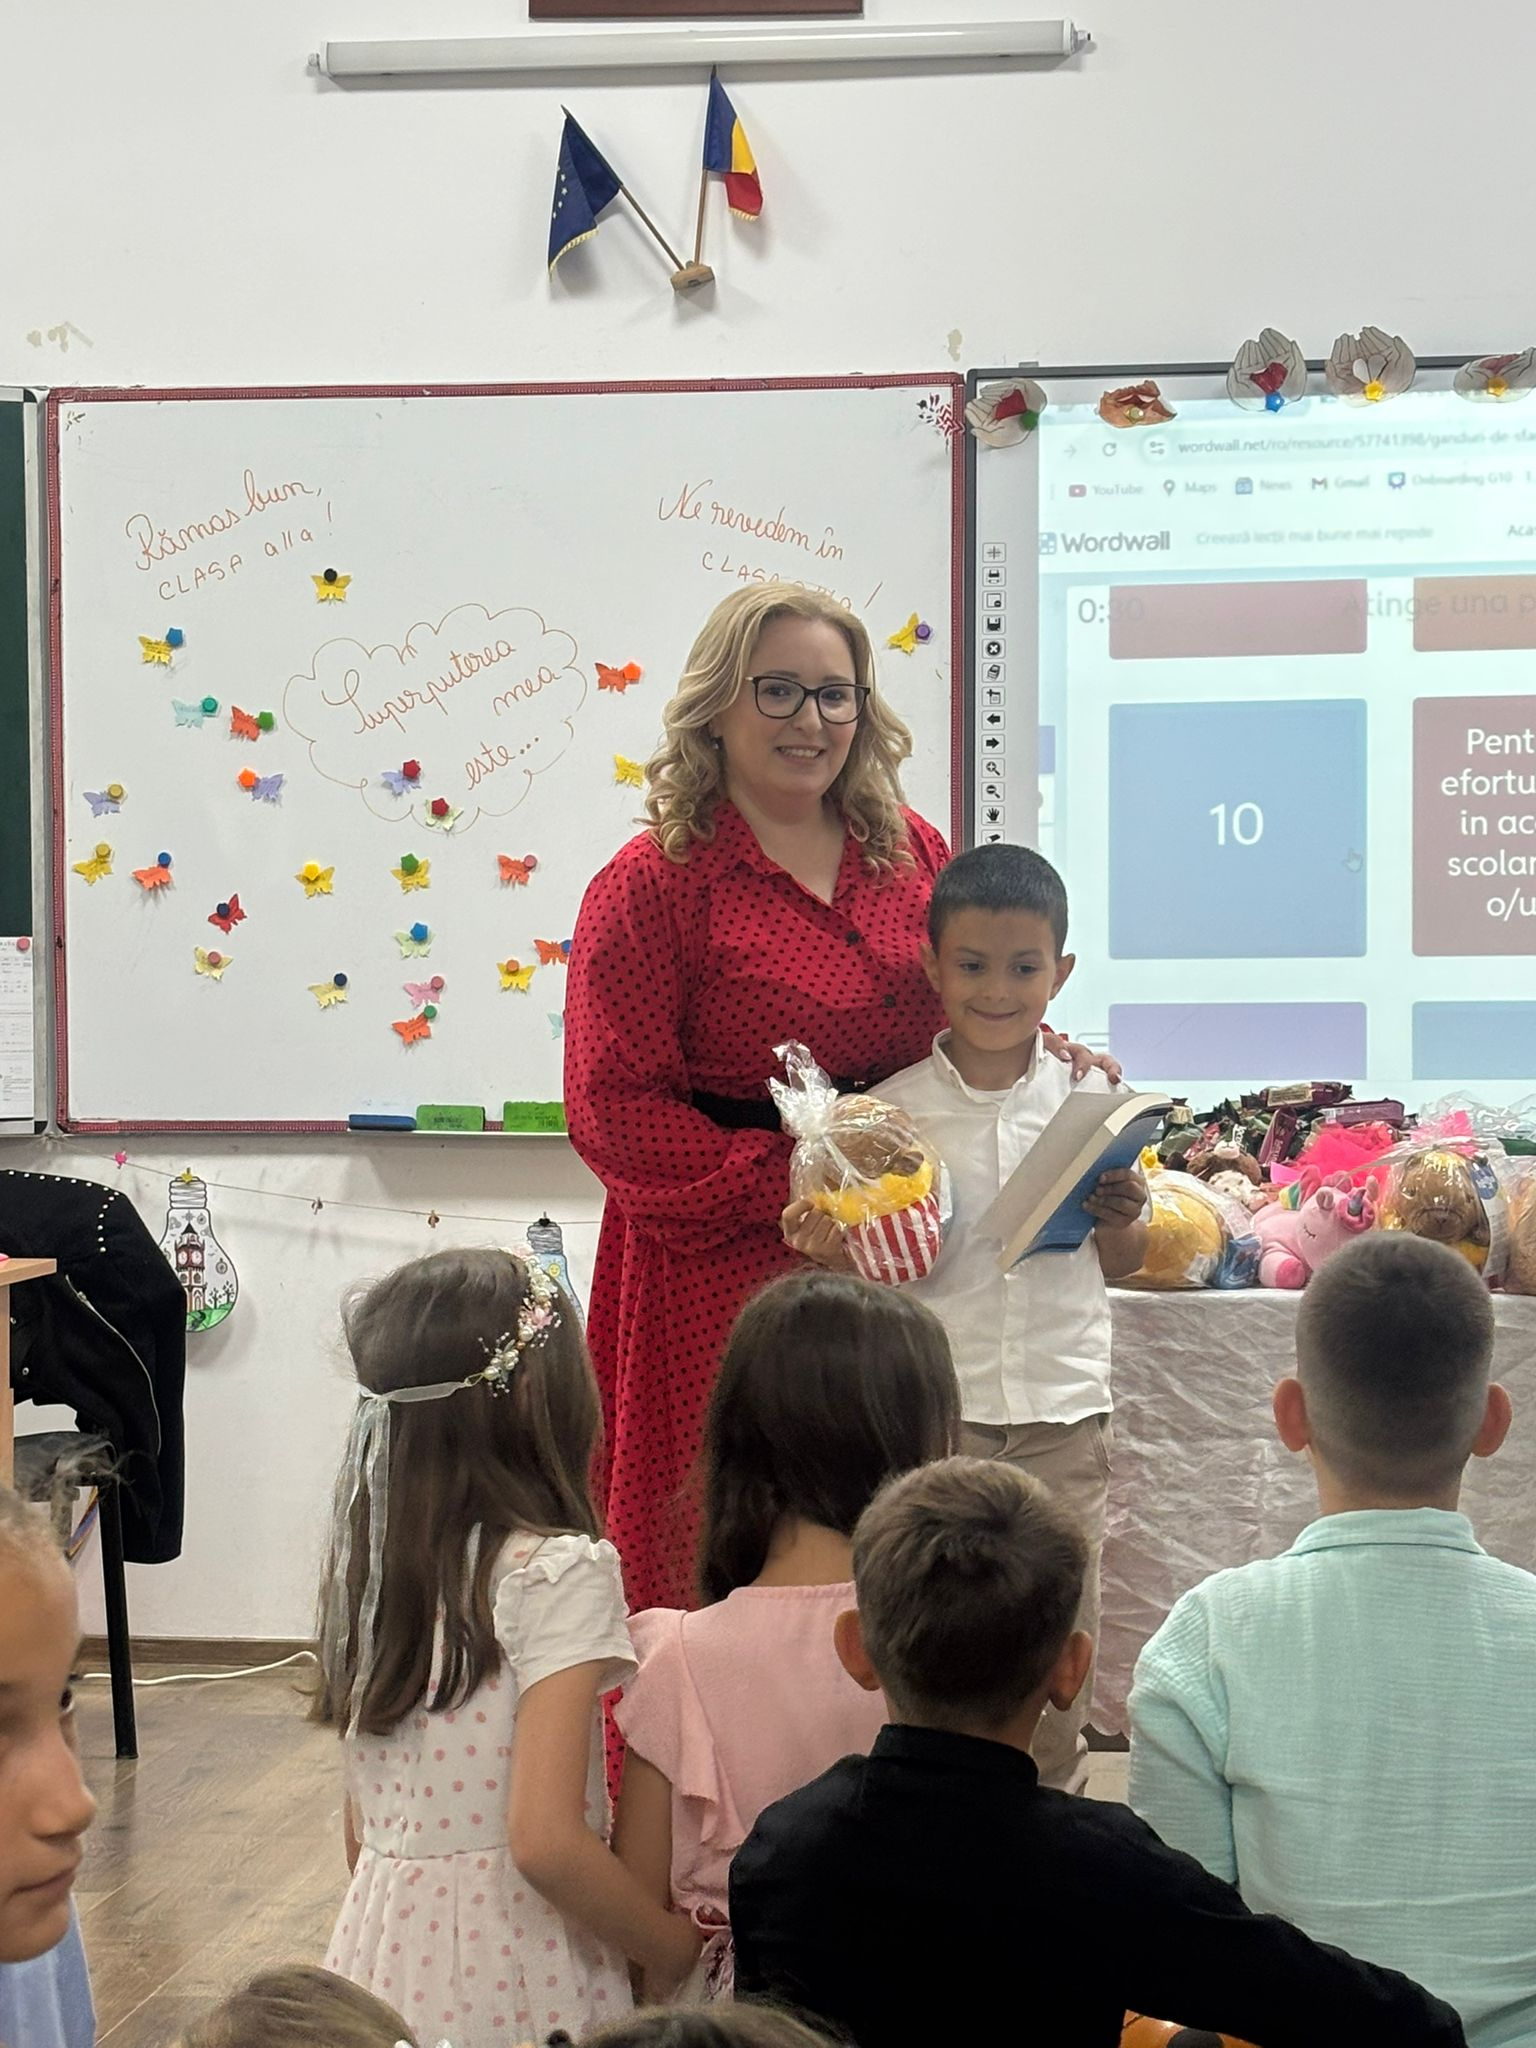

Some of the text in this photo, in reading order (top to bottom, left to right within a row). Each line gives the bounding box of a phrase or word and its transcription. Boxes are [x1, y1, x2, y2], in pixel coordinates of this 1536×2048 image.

[1092, 483, 1144, 496] YouTube
[1060, 530, 1171, 554] Wordwall
[1507, 524, 1536, 538] Aca
[158, 553, 243, 601] CLASA
[1342, 591, 1442, 622] Atinge
[1451, 593, 1508, 615] una
[492, 665, 562, 717] mea
[1466, 727, 1536, 756] Pent
[1208, 801, 1265, 846] 10
[1459, 809, 1536, 836] in ac
